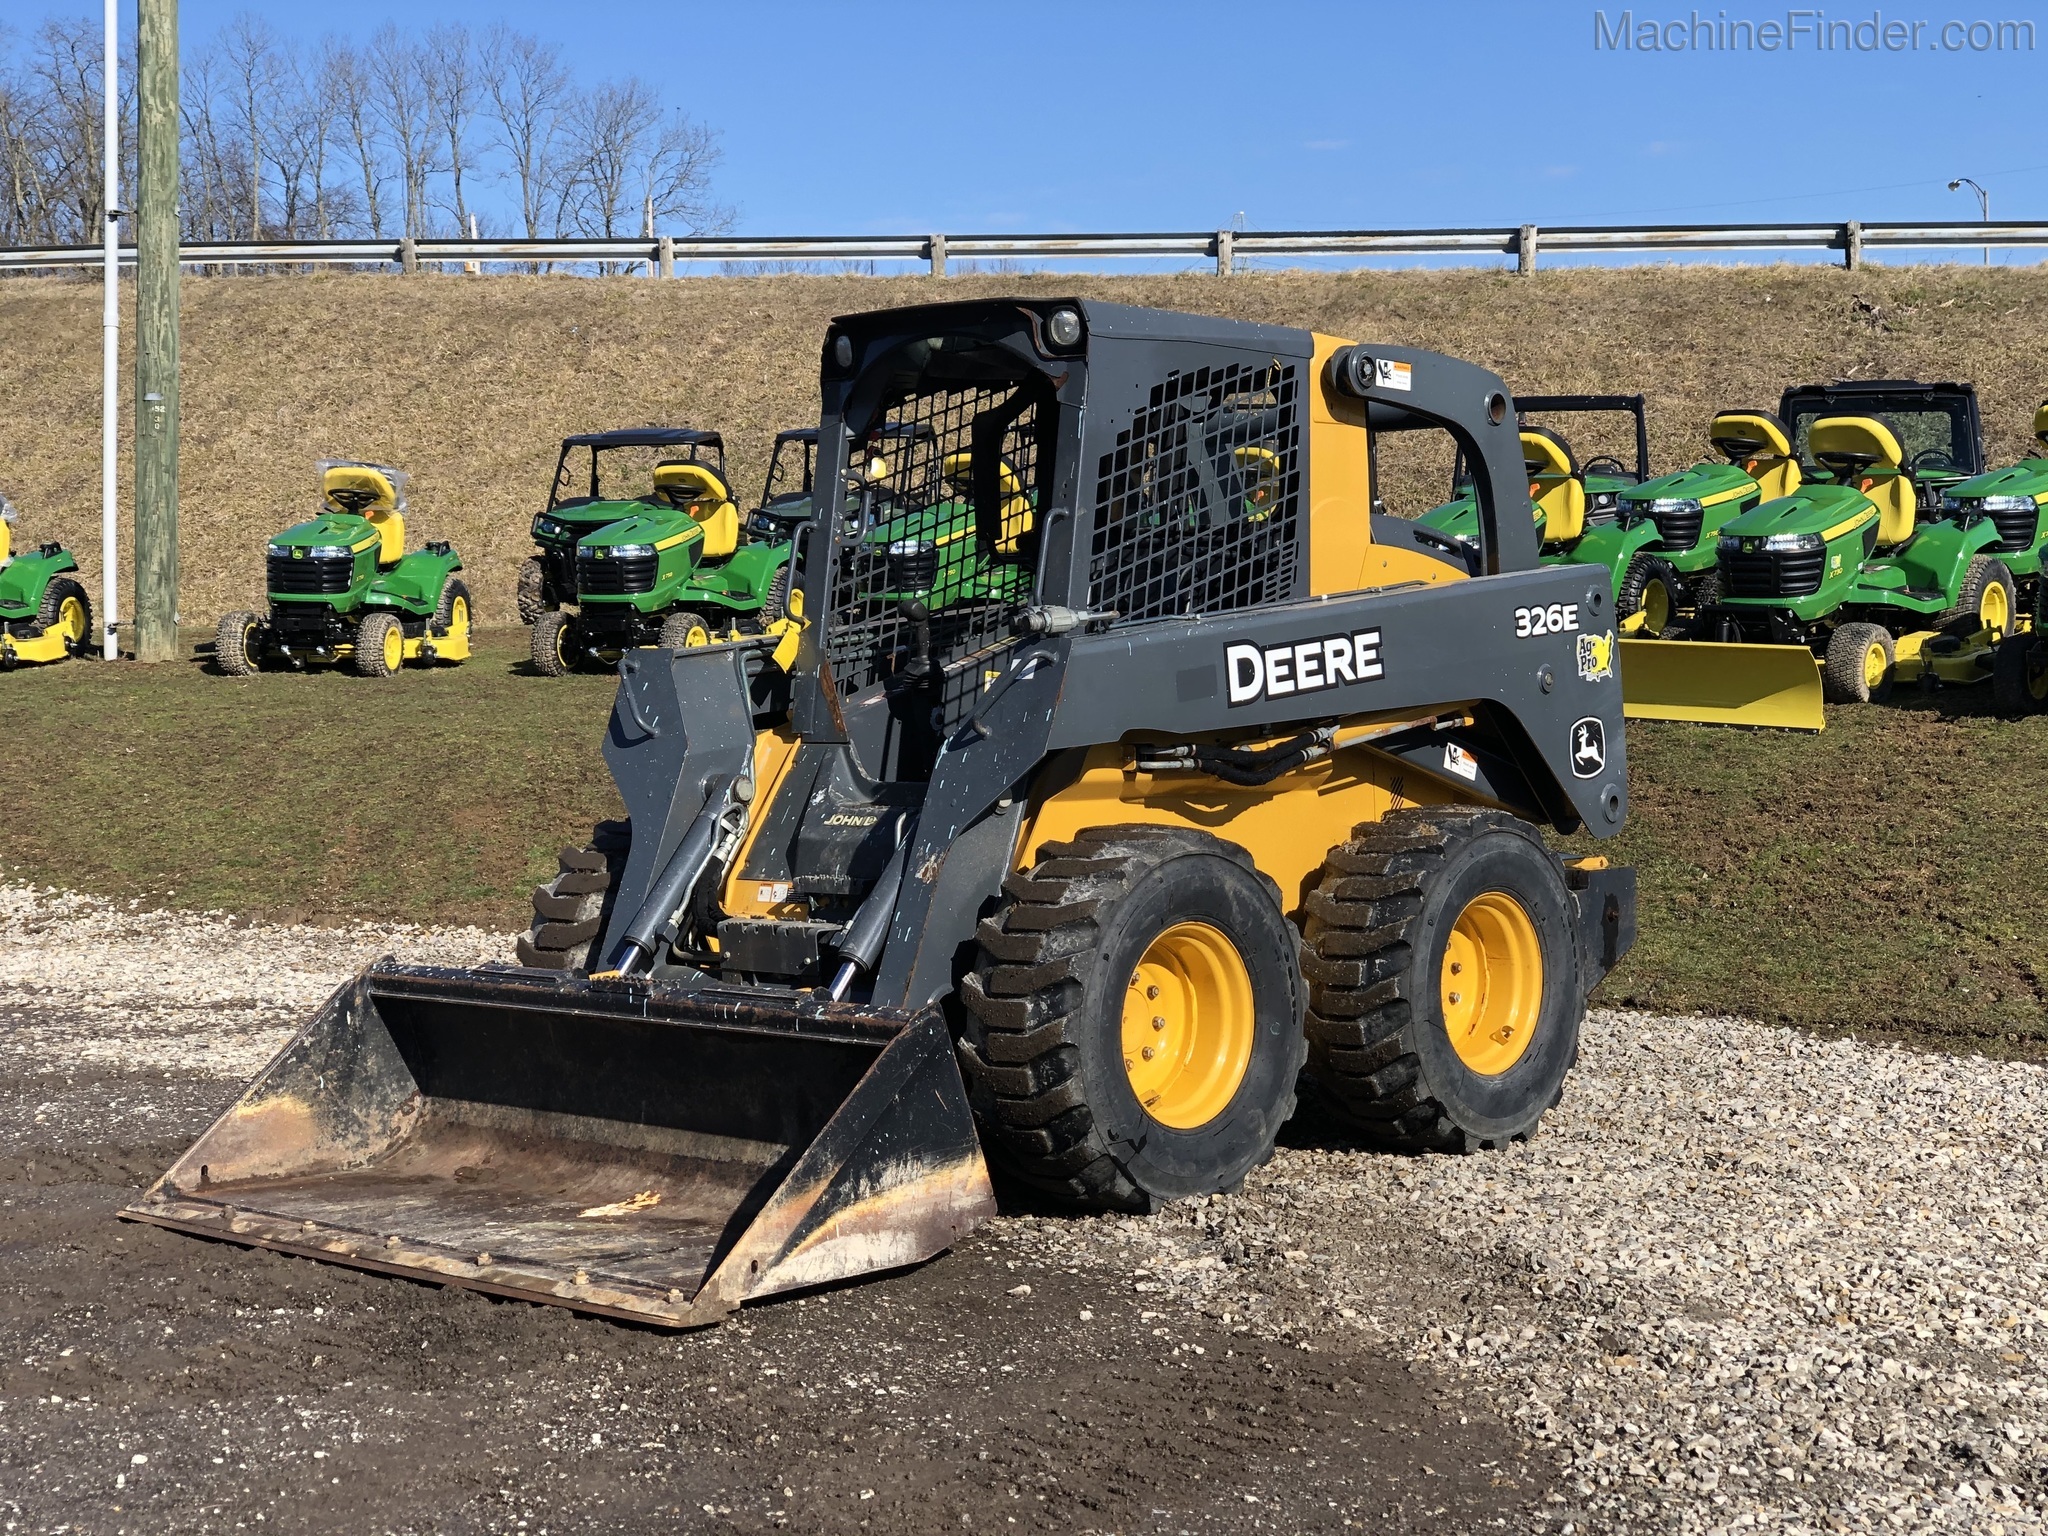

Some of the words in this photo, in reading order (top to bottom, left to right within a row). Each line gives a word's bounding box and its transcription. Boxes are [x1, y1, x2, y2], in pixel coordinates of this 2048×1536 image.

[1514, 603, 1579, 638] 326E
[1226, 631, 1383, 703] DEERE
[1580, 656, 1598, 672] Pro
[823, 814, 863, 826] JOHN
